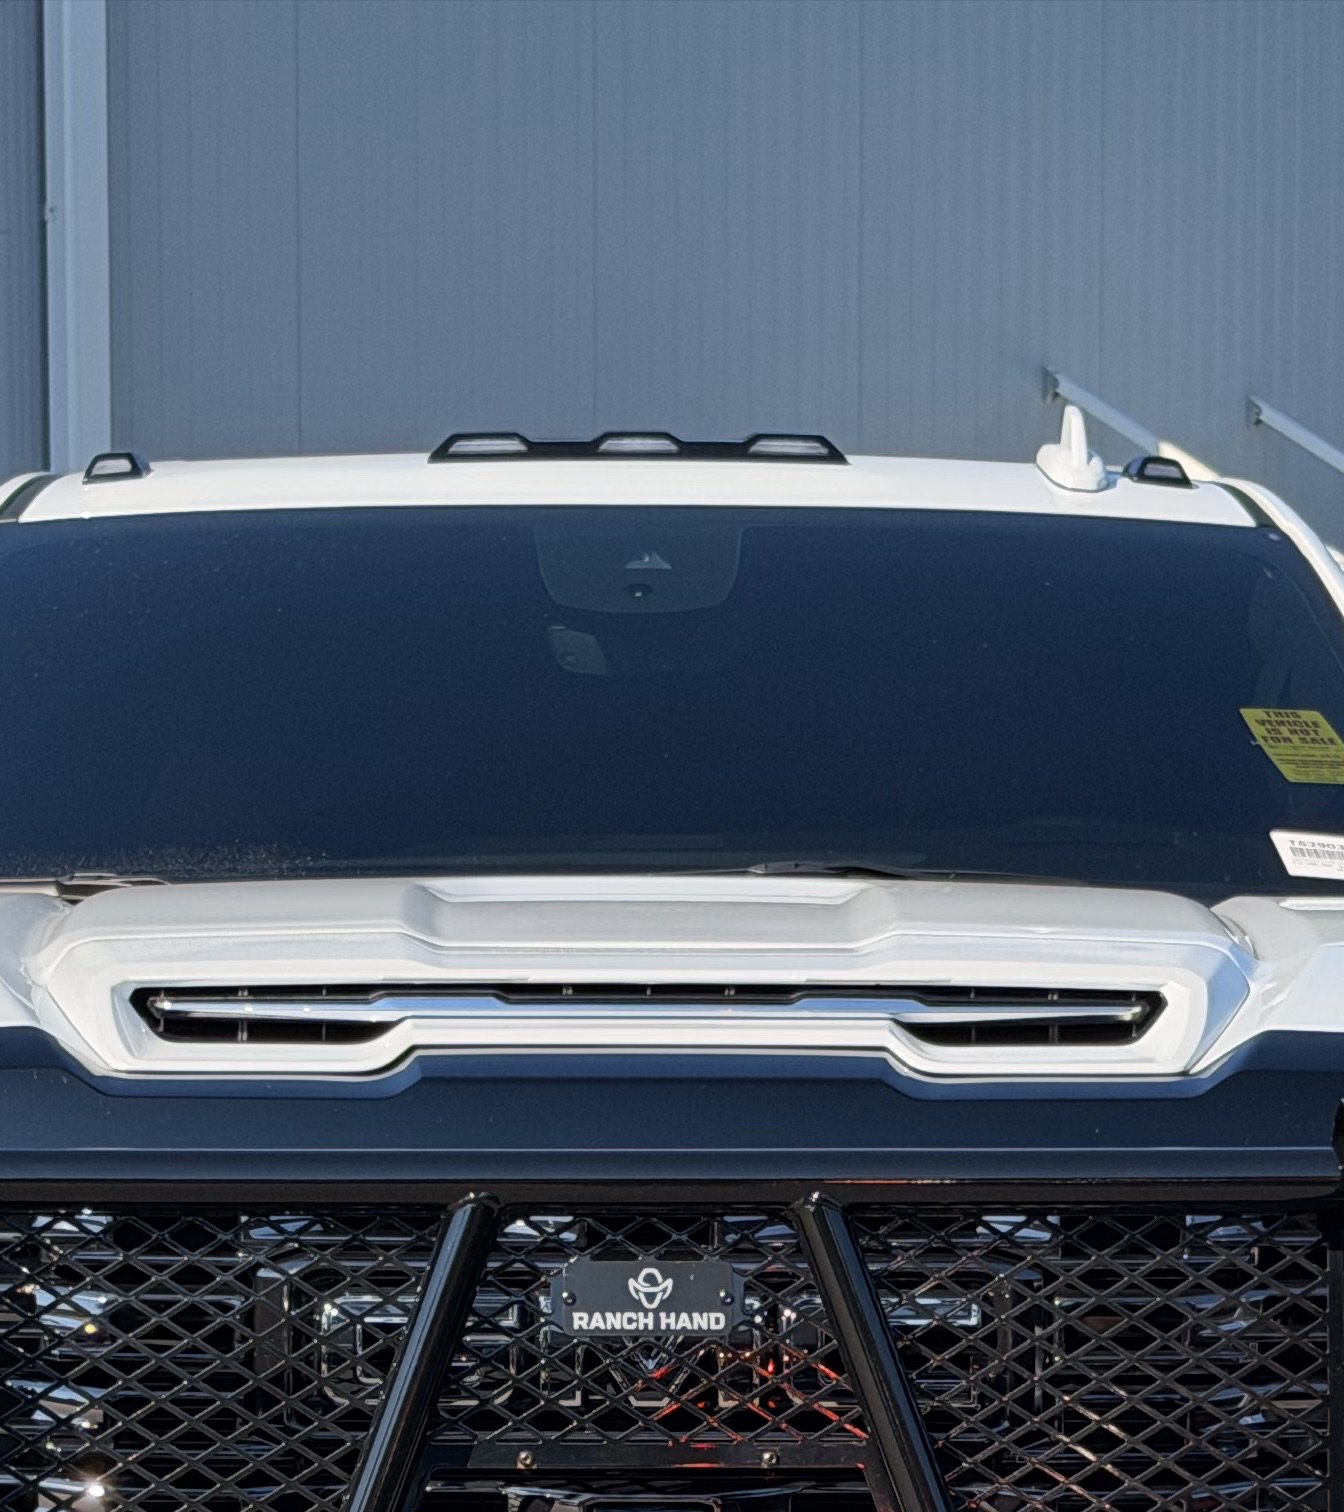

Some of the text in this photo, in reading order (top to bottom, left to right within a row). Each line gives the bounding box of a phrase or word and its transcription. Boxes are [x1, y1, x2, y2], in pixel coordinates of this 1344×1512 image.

[1264, 710, 1301, 719] THIS
[1255, 719, 1320, 728] VEHICLE
[1265, 727, 1320, 736] IS NOT
[1261, 736, 1338, 746] FOR SALE
[572, 1311, 726, 1331] RANCH HAND
